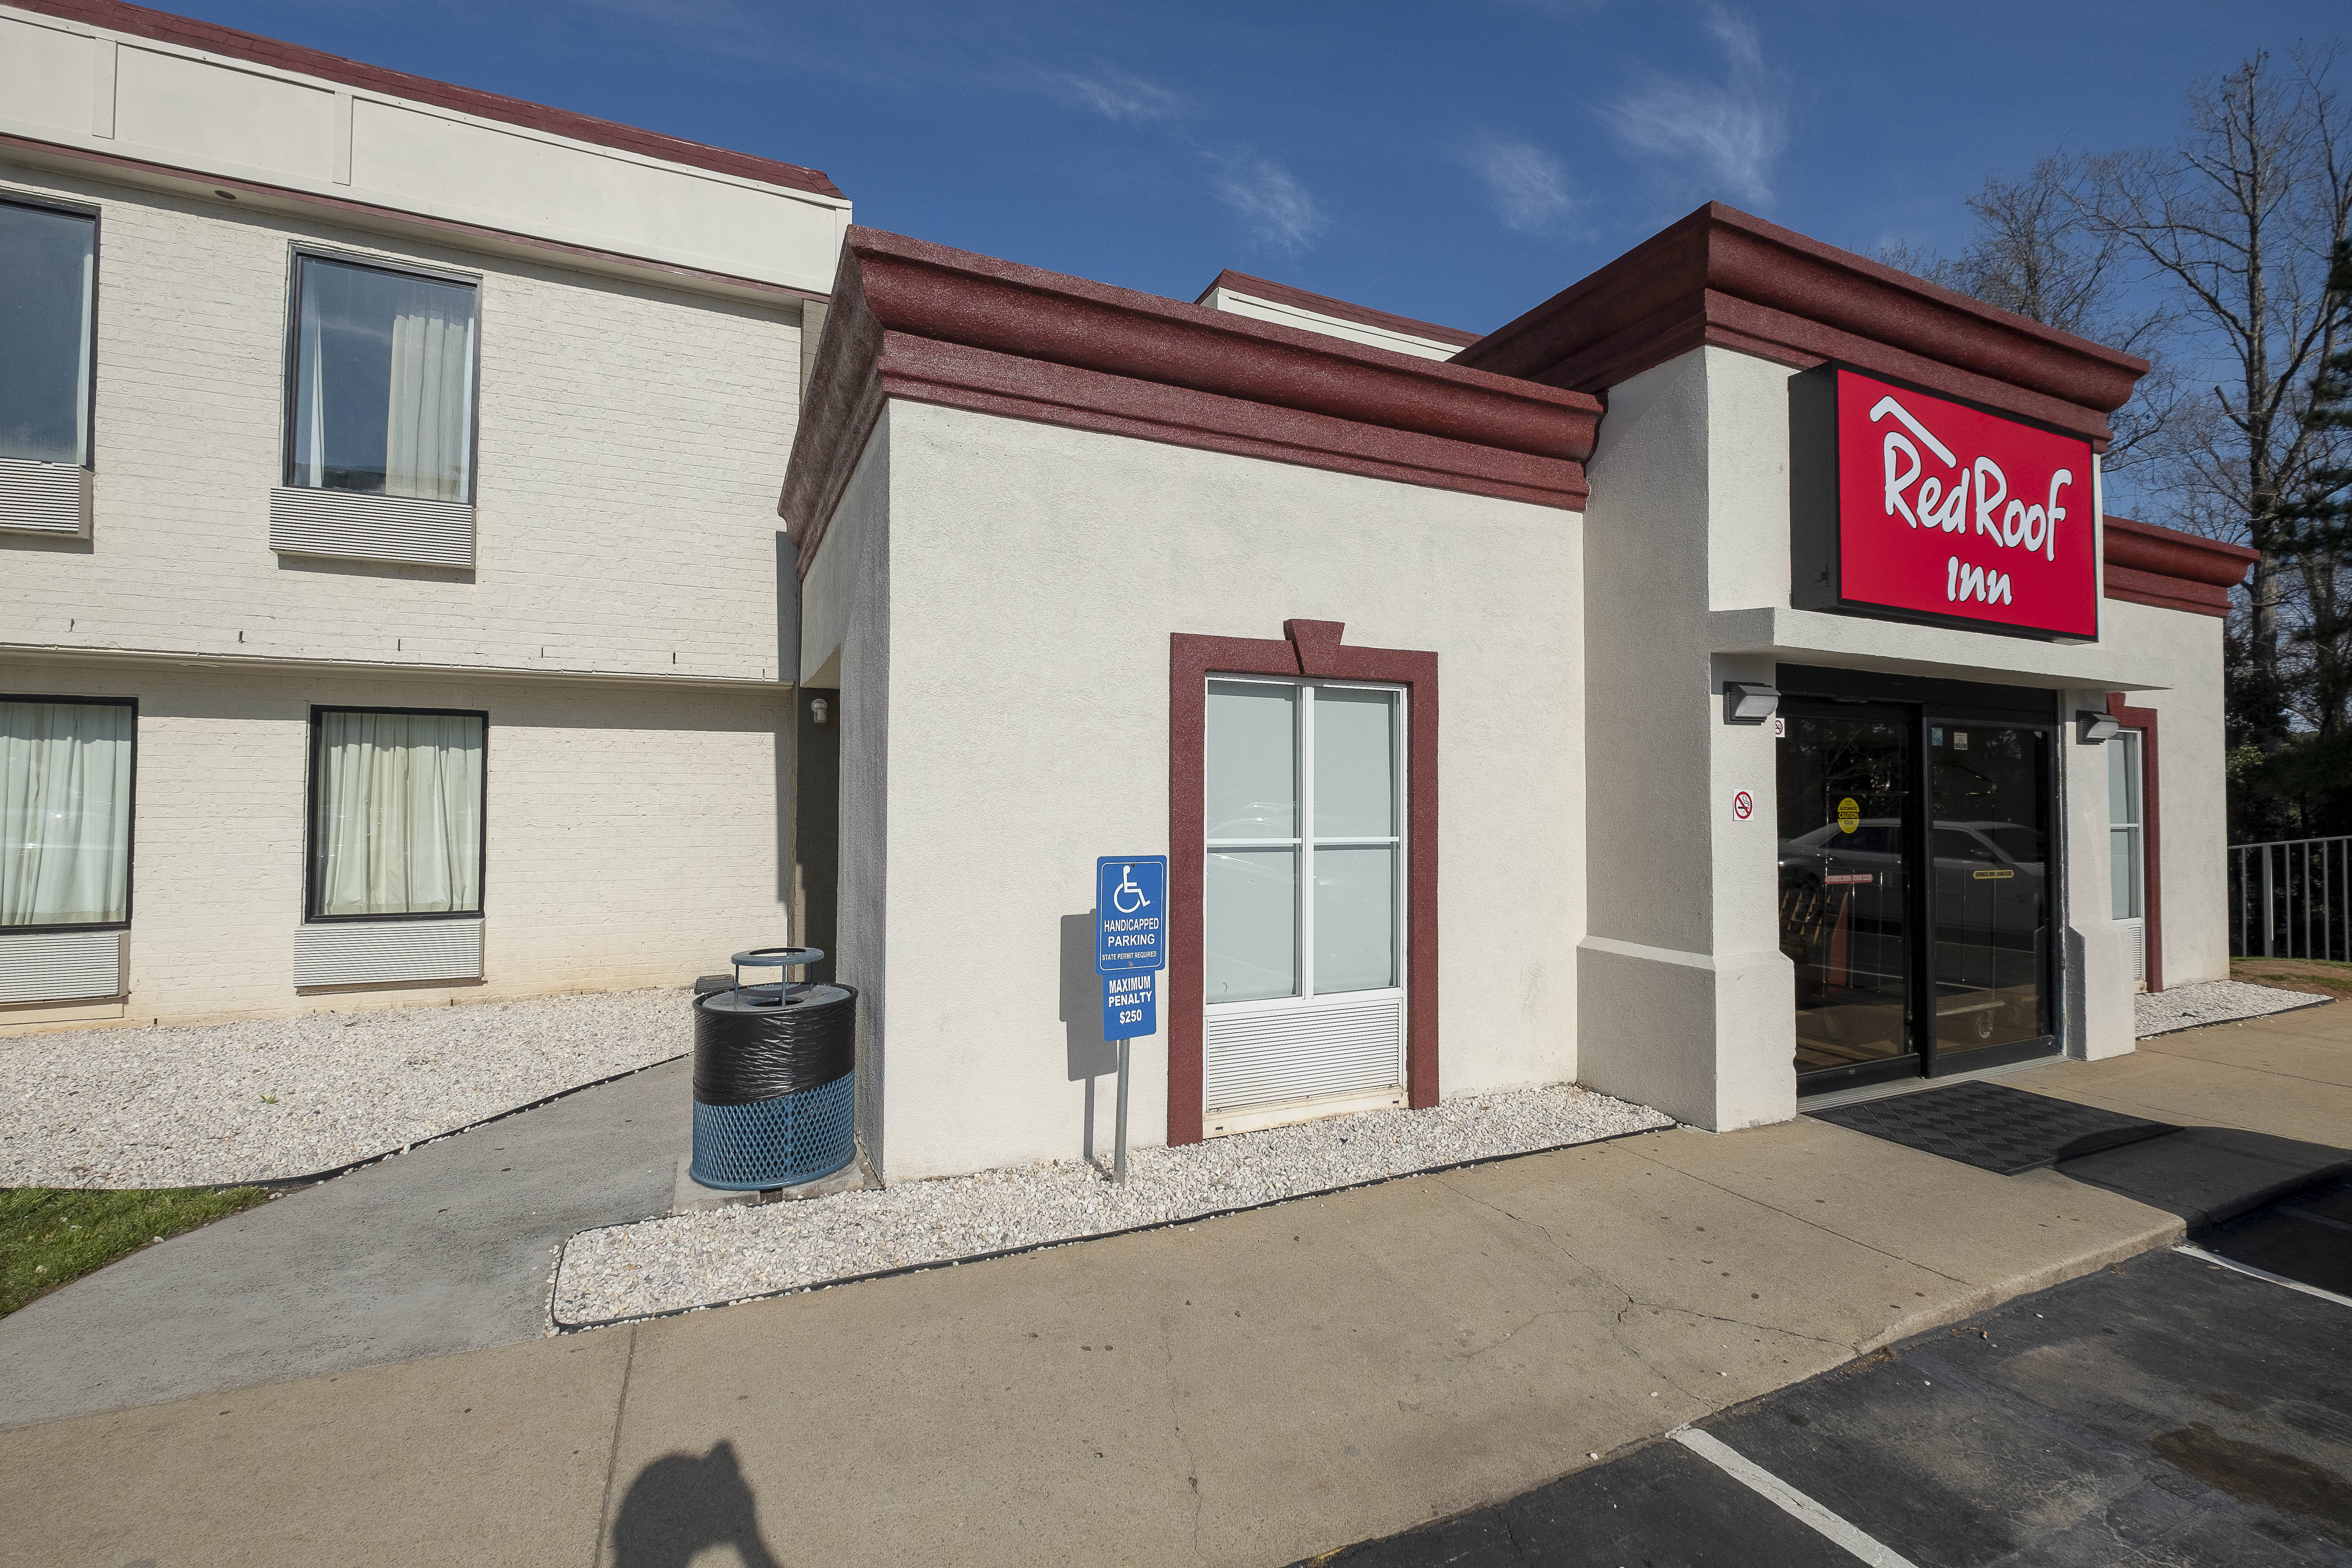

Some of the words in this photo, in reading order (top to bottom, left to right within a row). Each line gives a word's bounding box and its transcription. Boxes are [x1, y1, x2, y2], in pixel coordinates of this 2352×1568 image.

[1884, 432, 1970, 534] Red
[1975, 456, 2072, 561] Roof
[1104, 918, 1159, 932] HANDICAPPED
[1108, 933, 1155, 947] PARKING
[1109, 975, 1151, 994] MAXIMUM
[1109, 991, 1152, 1007] PENALTY
[1120, 1009, 1142, 1025] $250
